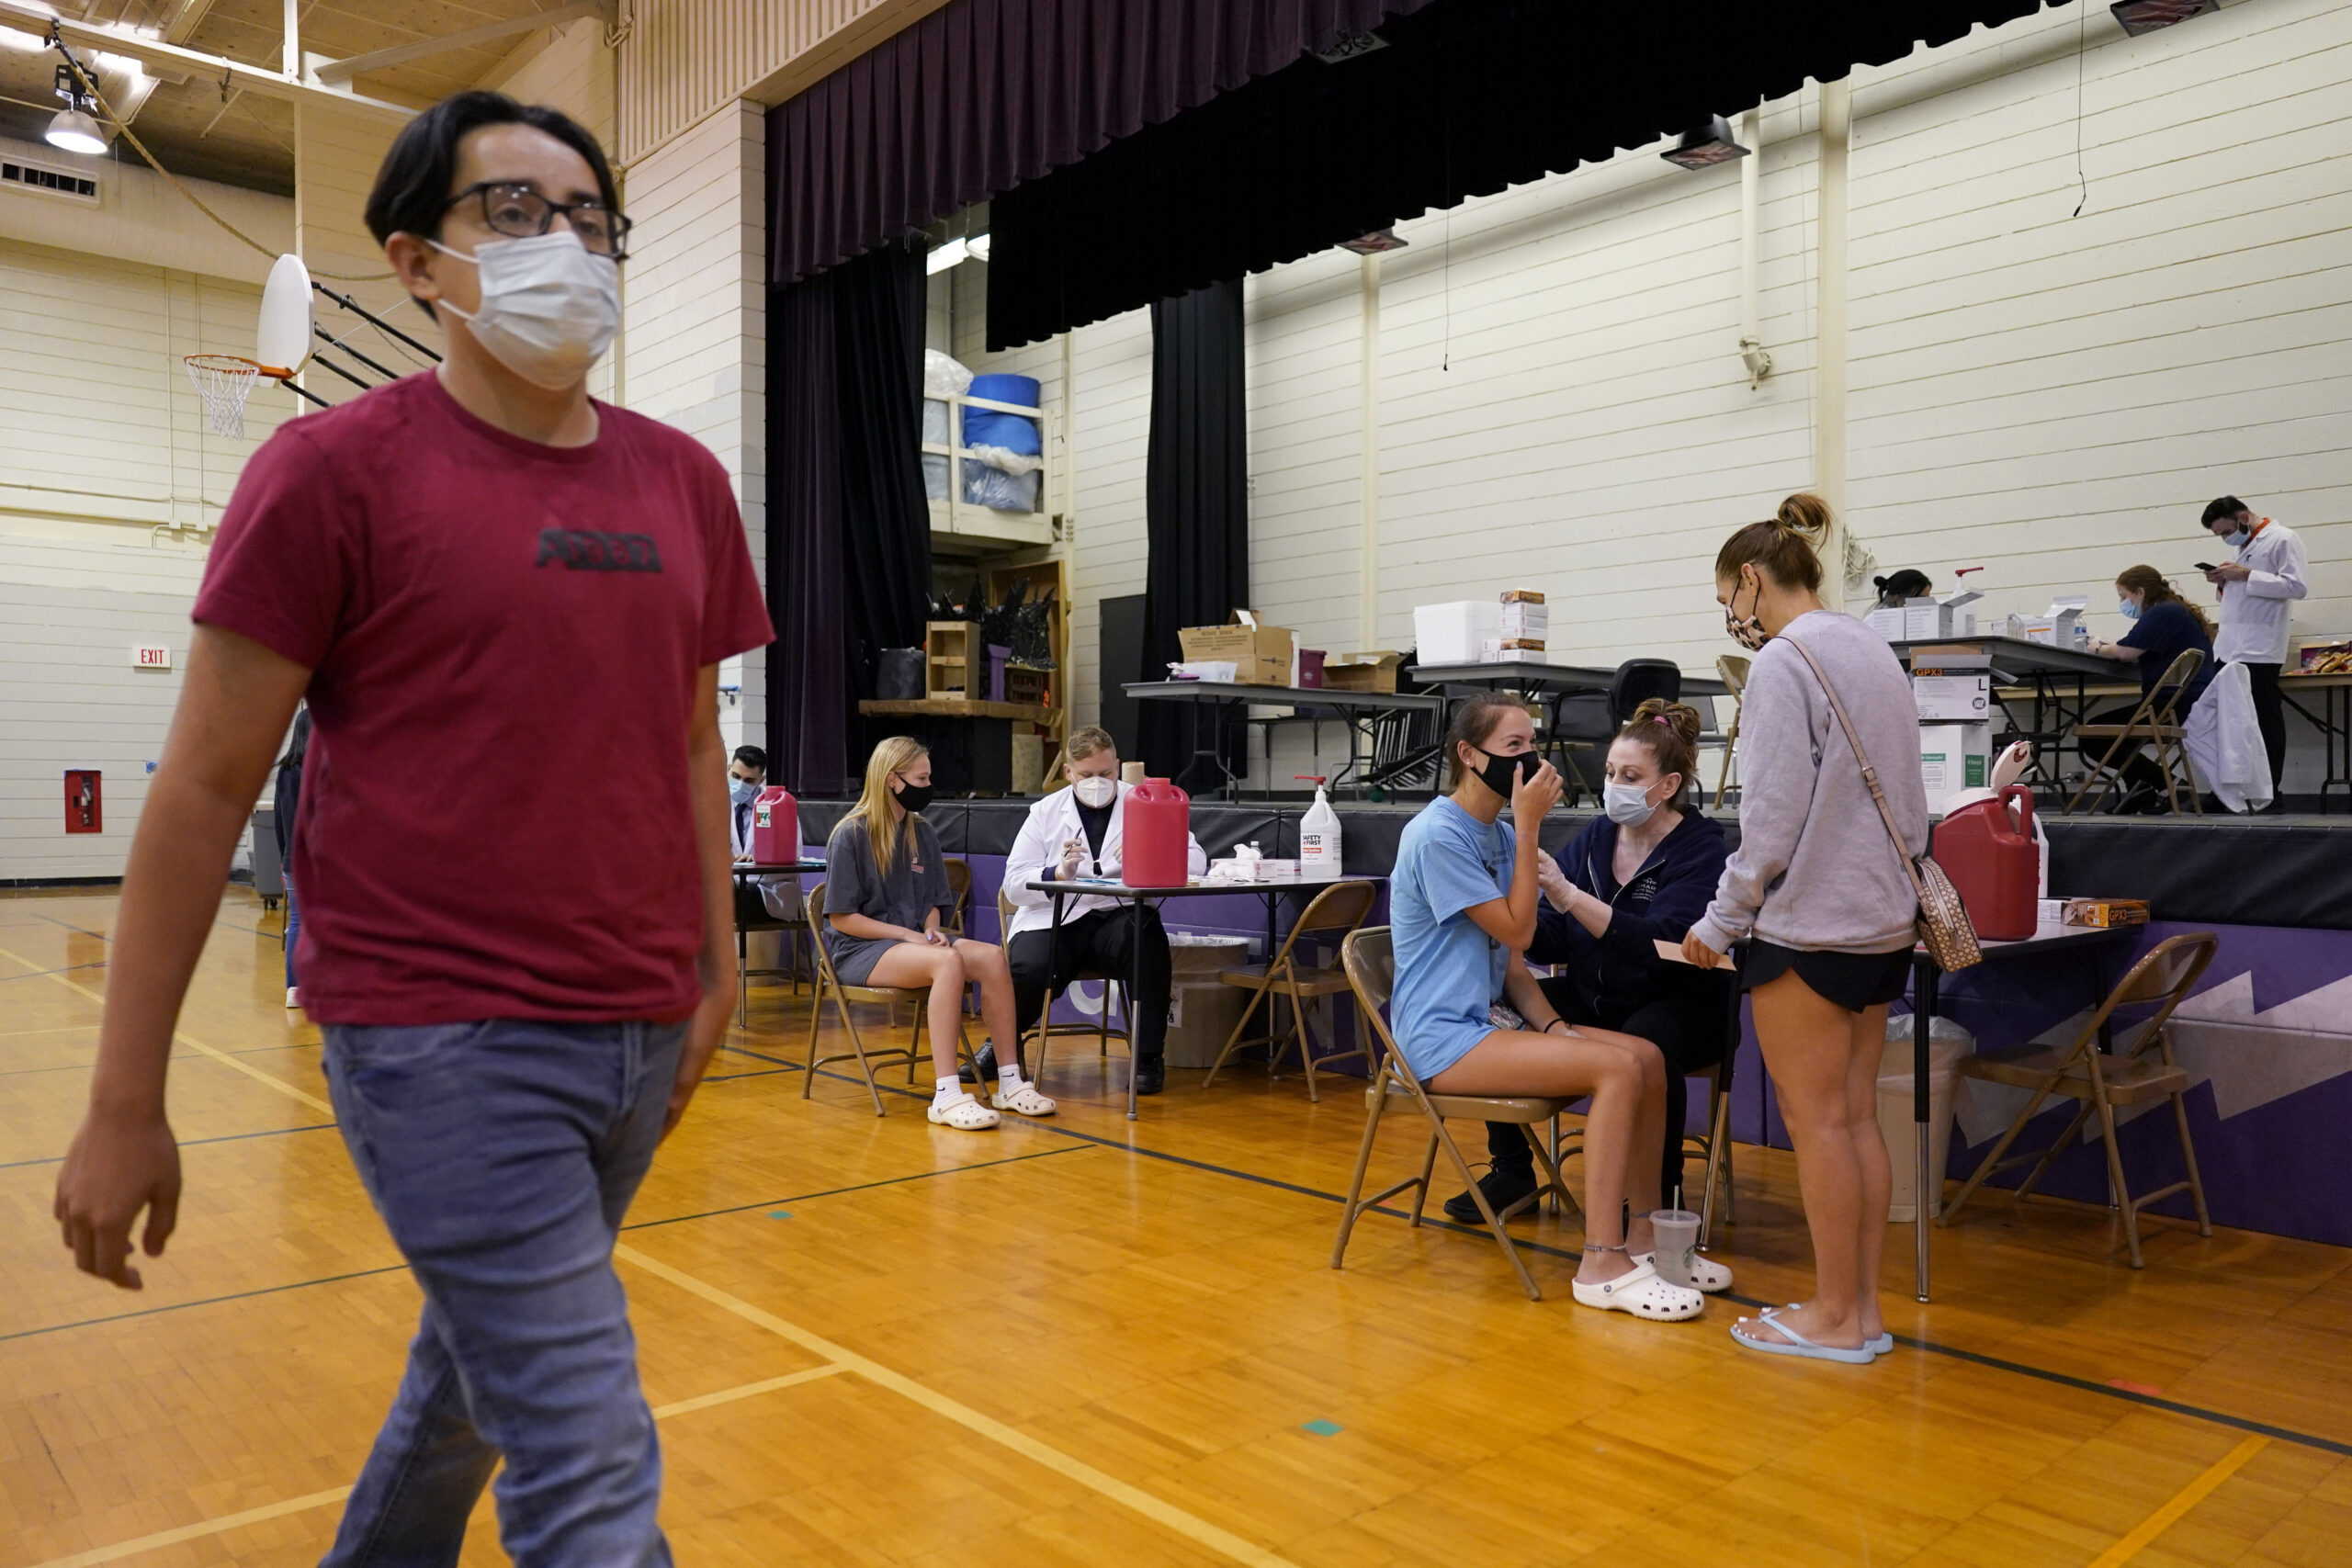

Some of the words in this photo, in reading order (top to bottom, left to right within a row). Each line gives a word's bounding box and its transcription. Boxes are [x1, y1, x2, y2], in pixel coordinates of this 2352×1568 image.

[141, 649, 164, 664] EXIT
[1916, 668, 1943, 676] GPX3
[1978, 678, 1987, 691] L
[2109, 908, 2128, 921] GPX3
